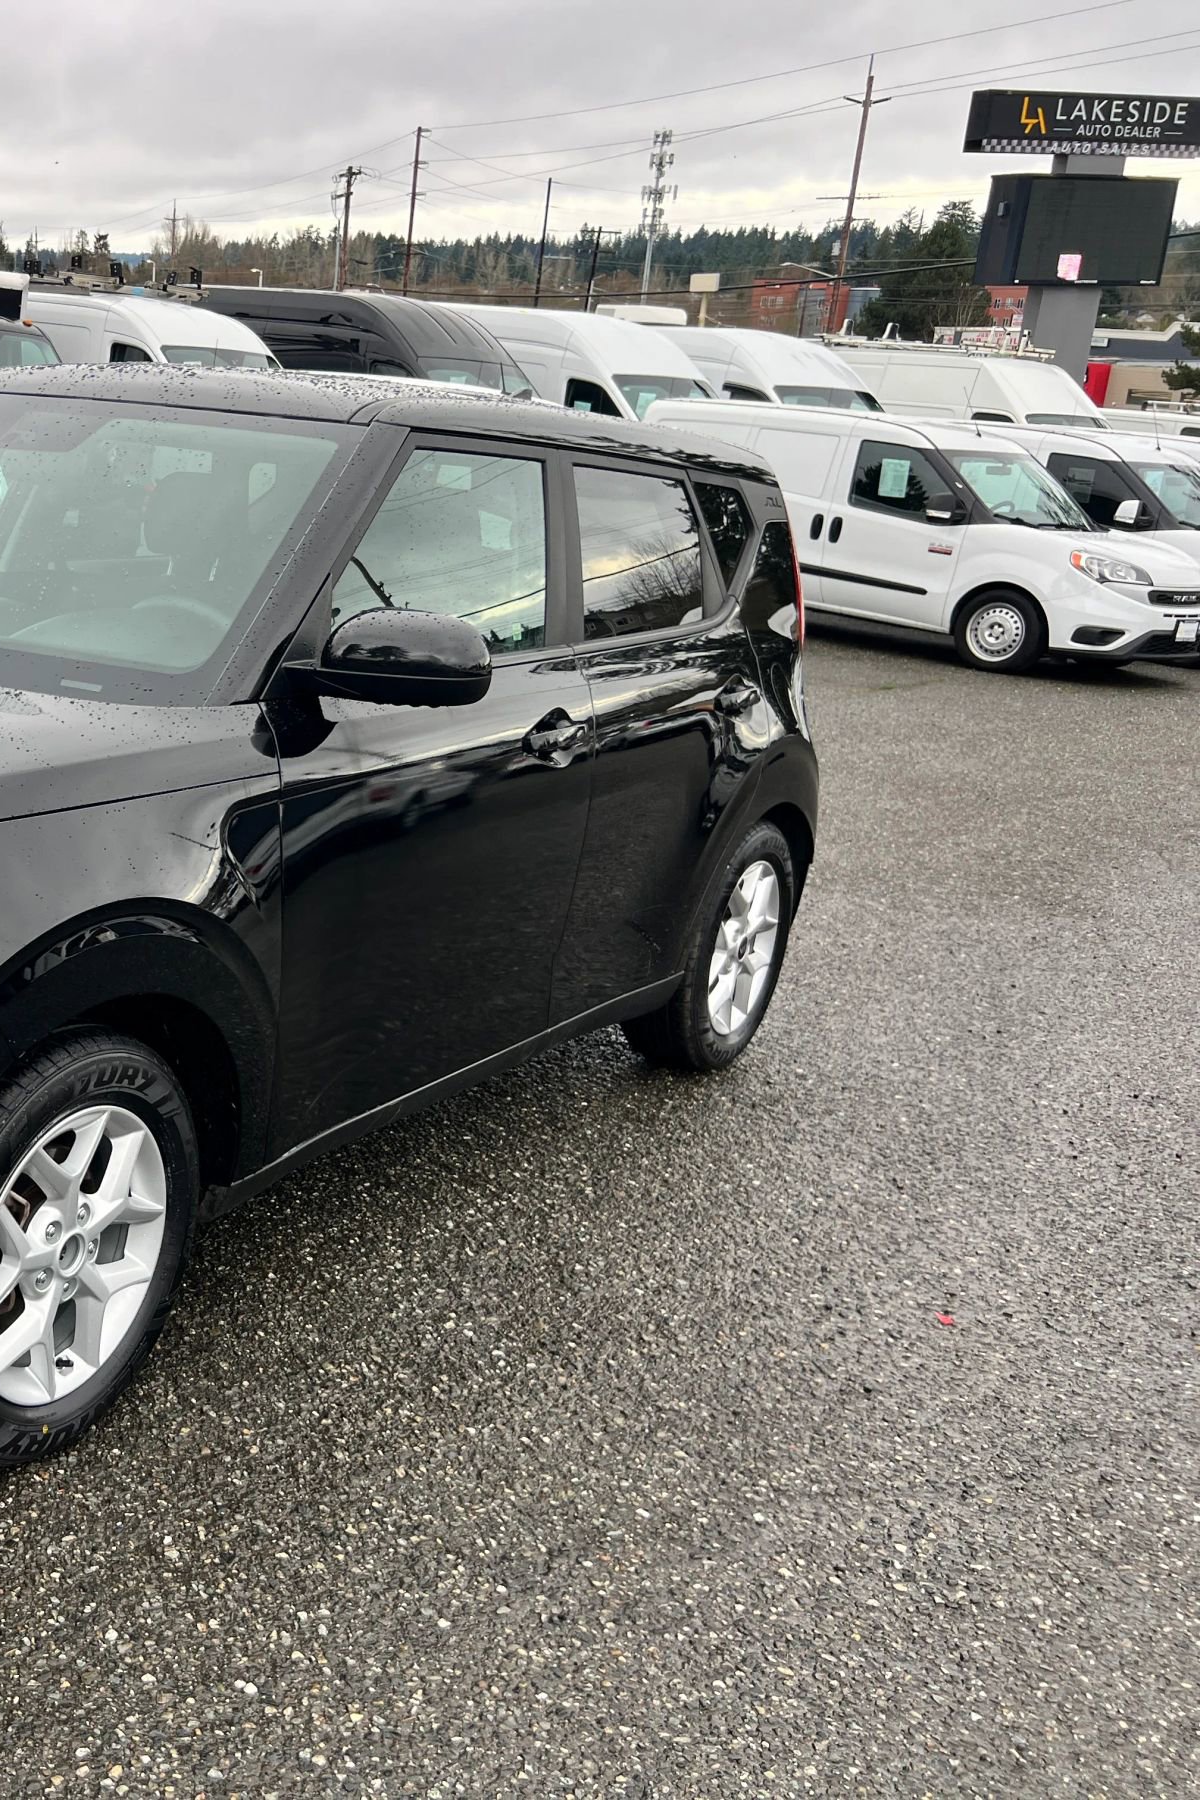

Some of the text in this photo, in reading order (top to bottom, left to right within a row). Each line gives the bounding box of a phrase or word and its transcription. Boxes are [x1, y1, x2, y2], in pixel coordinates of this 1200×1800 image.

[1055, 98, 1189, 124] LAKESIDE
[1076, 124, 1161, 138] AUTO DEALER
[1050, 142, 1150, 155] AUTO SALES
